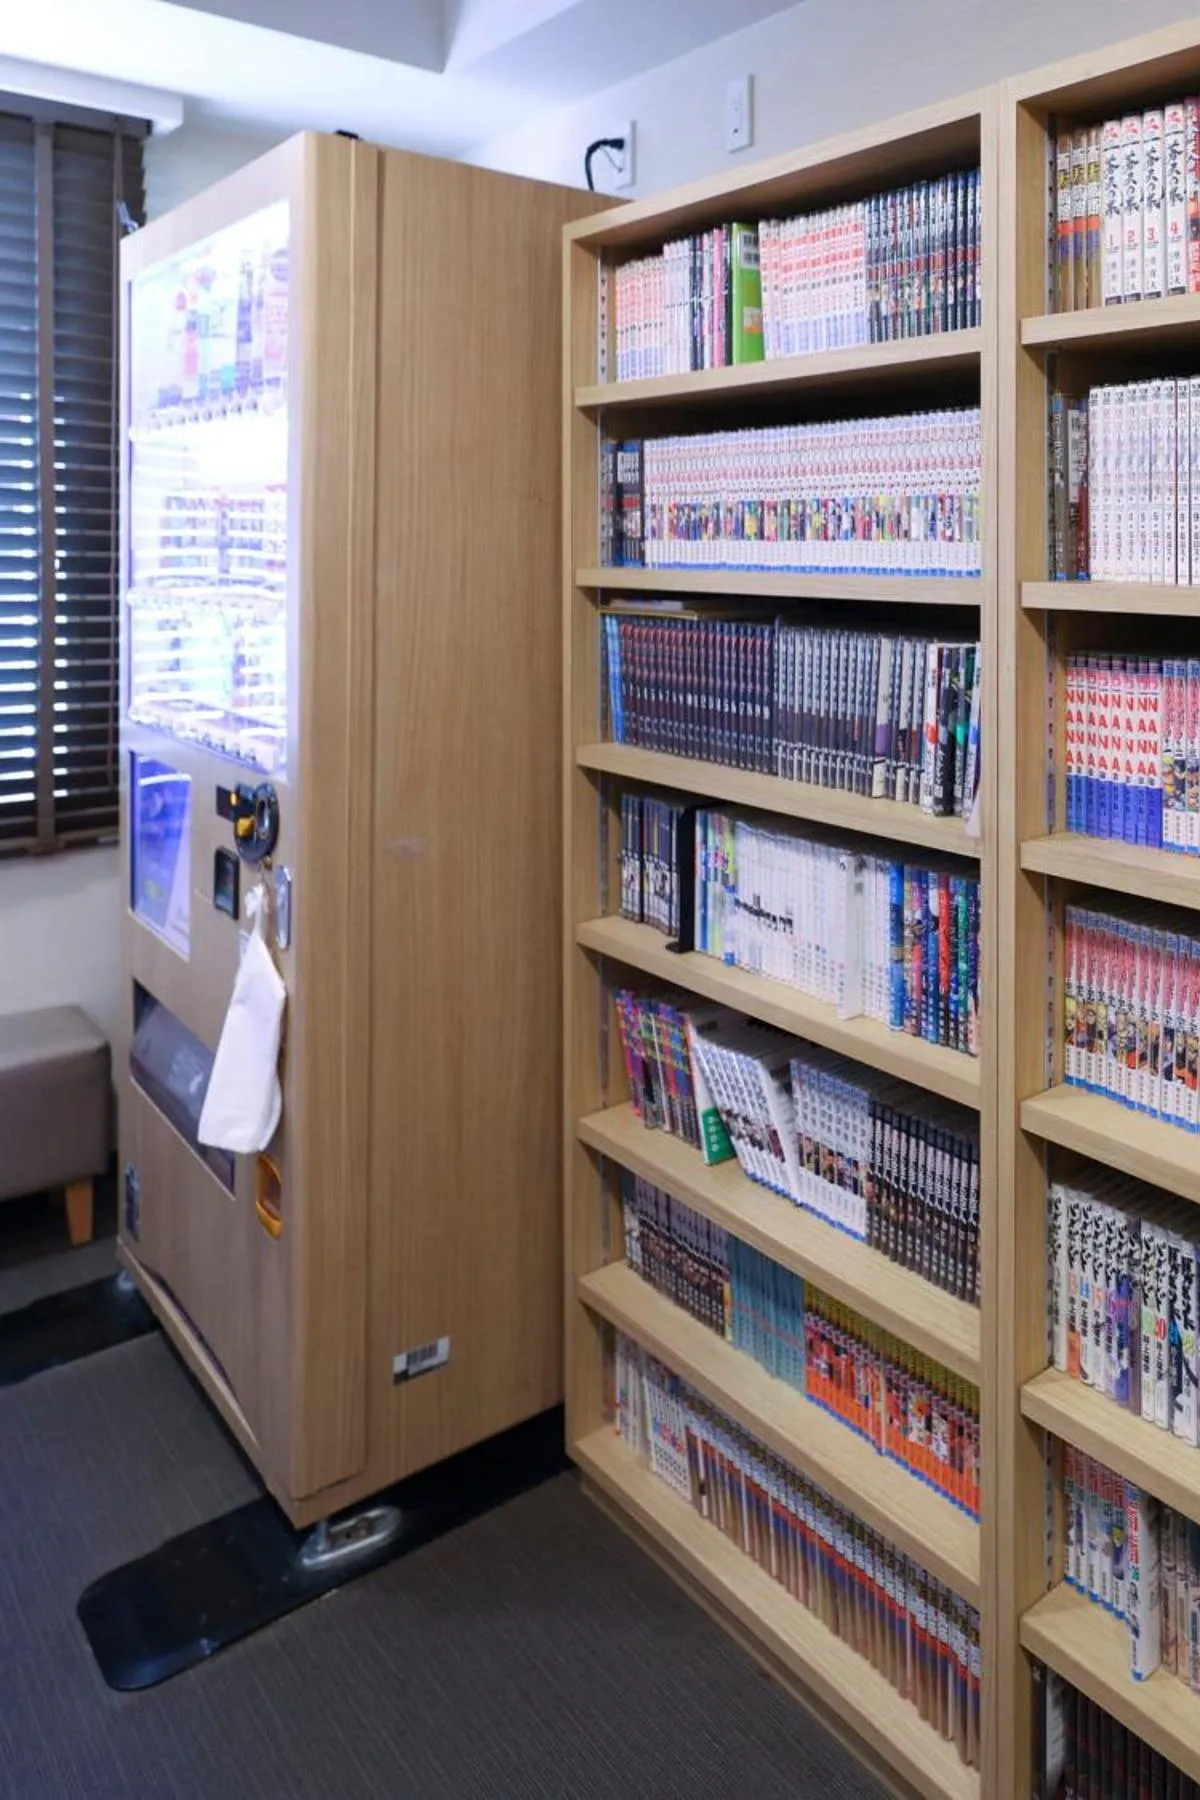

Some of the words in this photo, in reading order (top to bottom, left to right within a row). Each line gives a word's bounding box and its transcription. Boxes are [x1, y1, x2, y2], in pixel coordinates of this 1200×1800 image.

[1147, 228, 1155, 241] 3
[1170, 222, 1178, 235] 4
[1109, 234, 1114, 245] 1
[1127, 230, 1136, 242] 2
